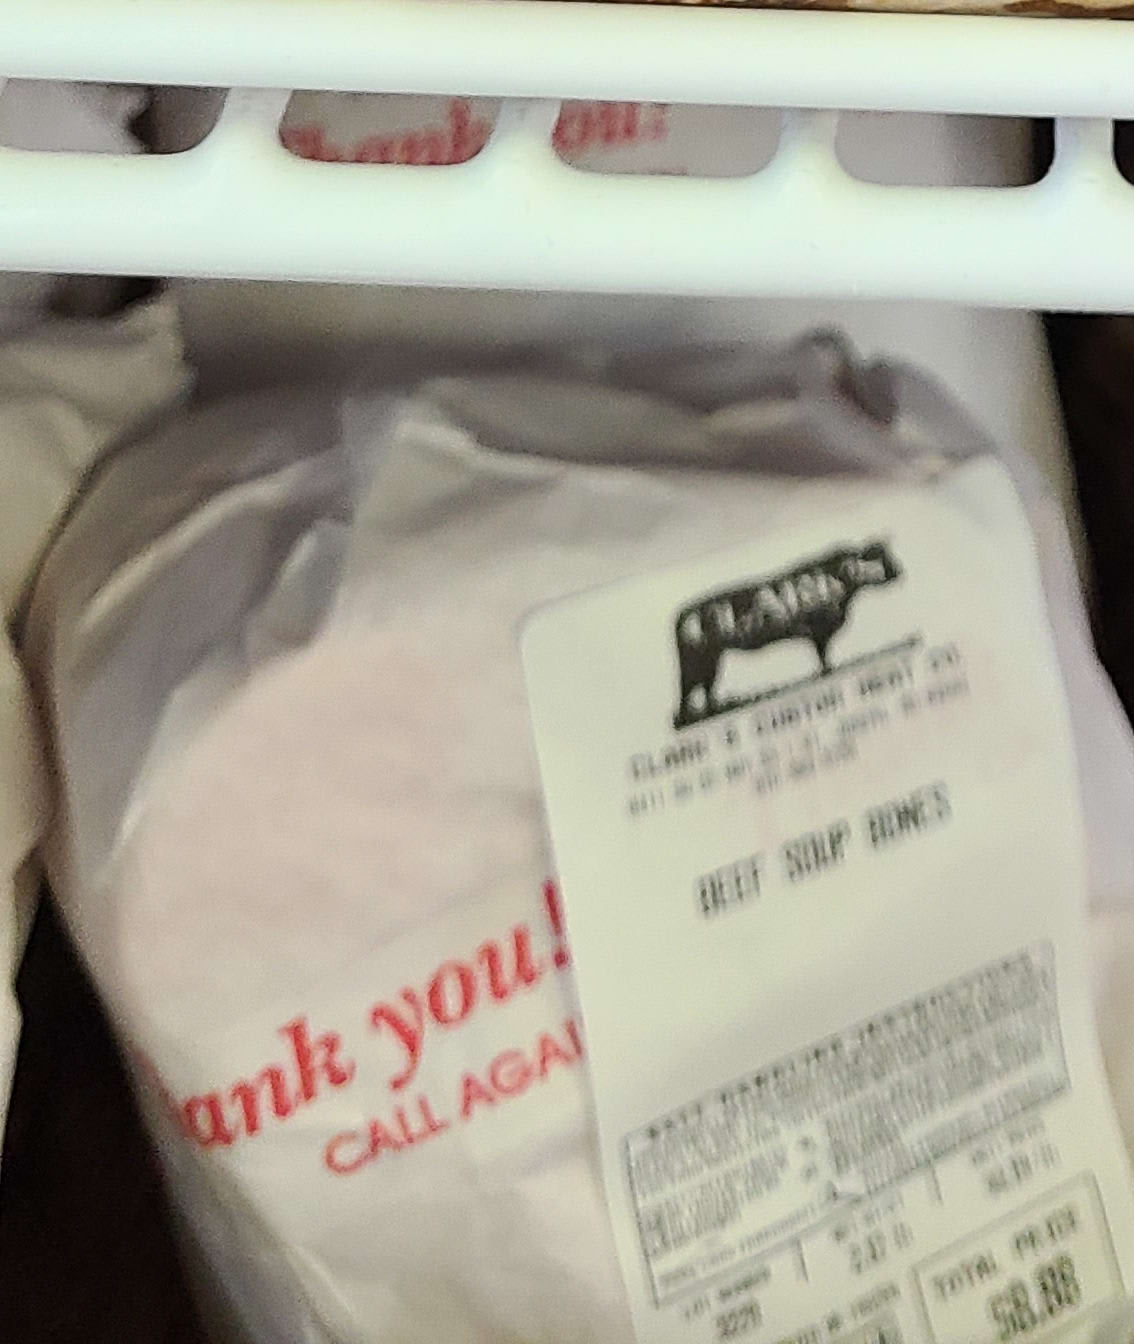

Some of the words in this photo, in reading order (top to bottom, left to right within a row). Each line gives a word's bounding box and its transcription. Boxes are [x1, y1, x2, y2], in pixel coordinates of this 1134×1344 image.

[367, 878, 571, 1093] you!
[323, 1095, 451, 1176] CALL
[459, 1017, 585, 1123] AGAI
